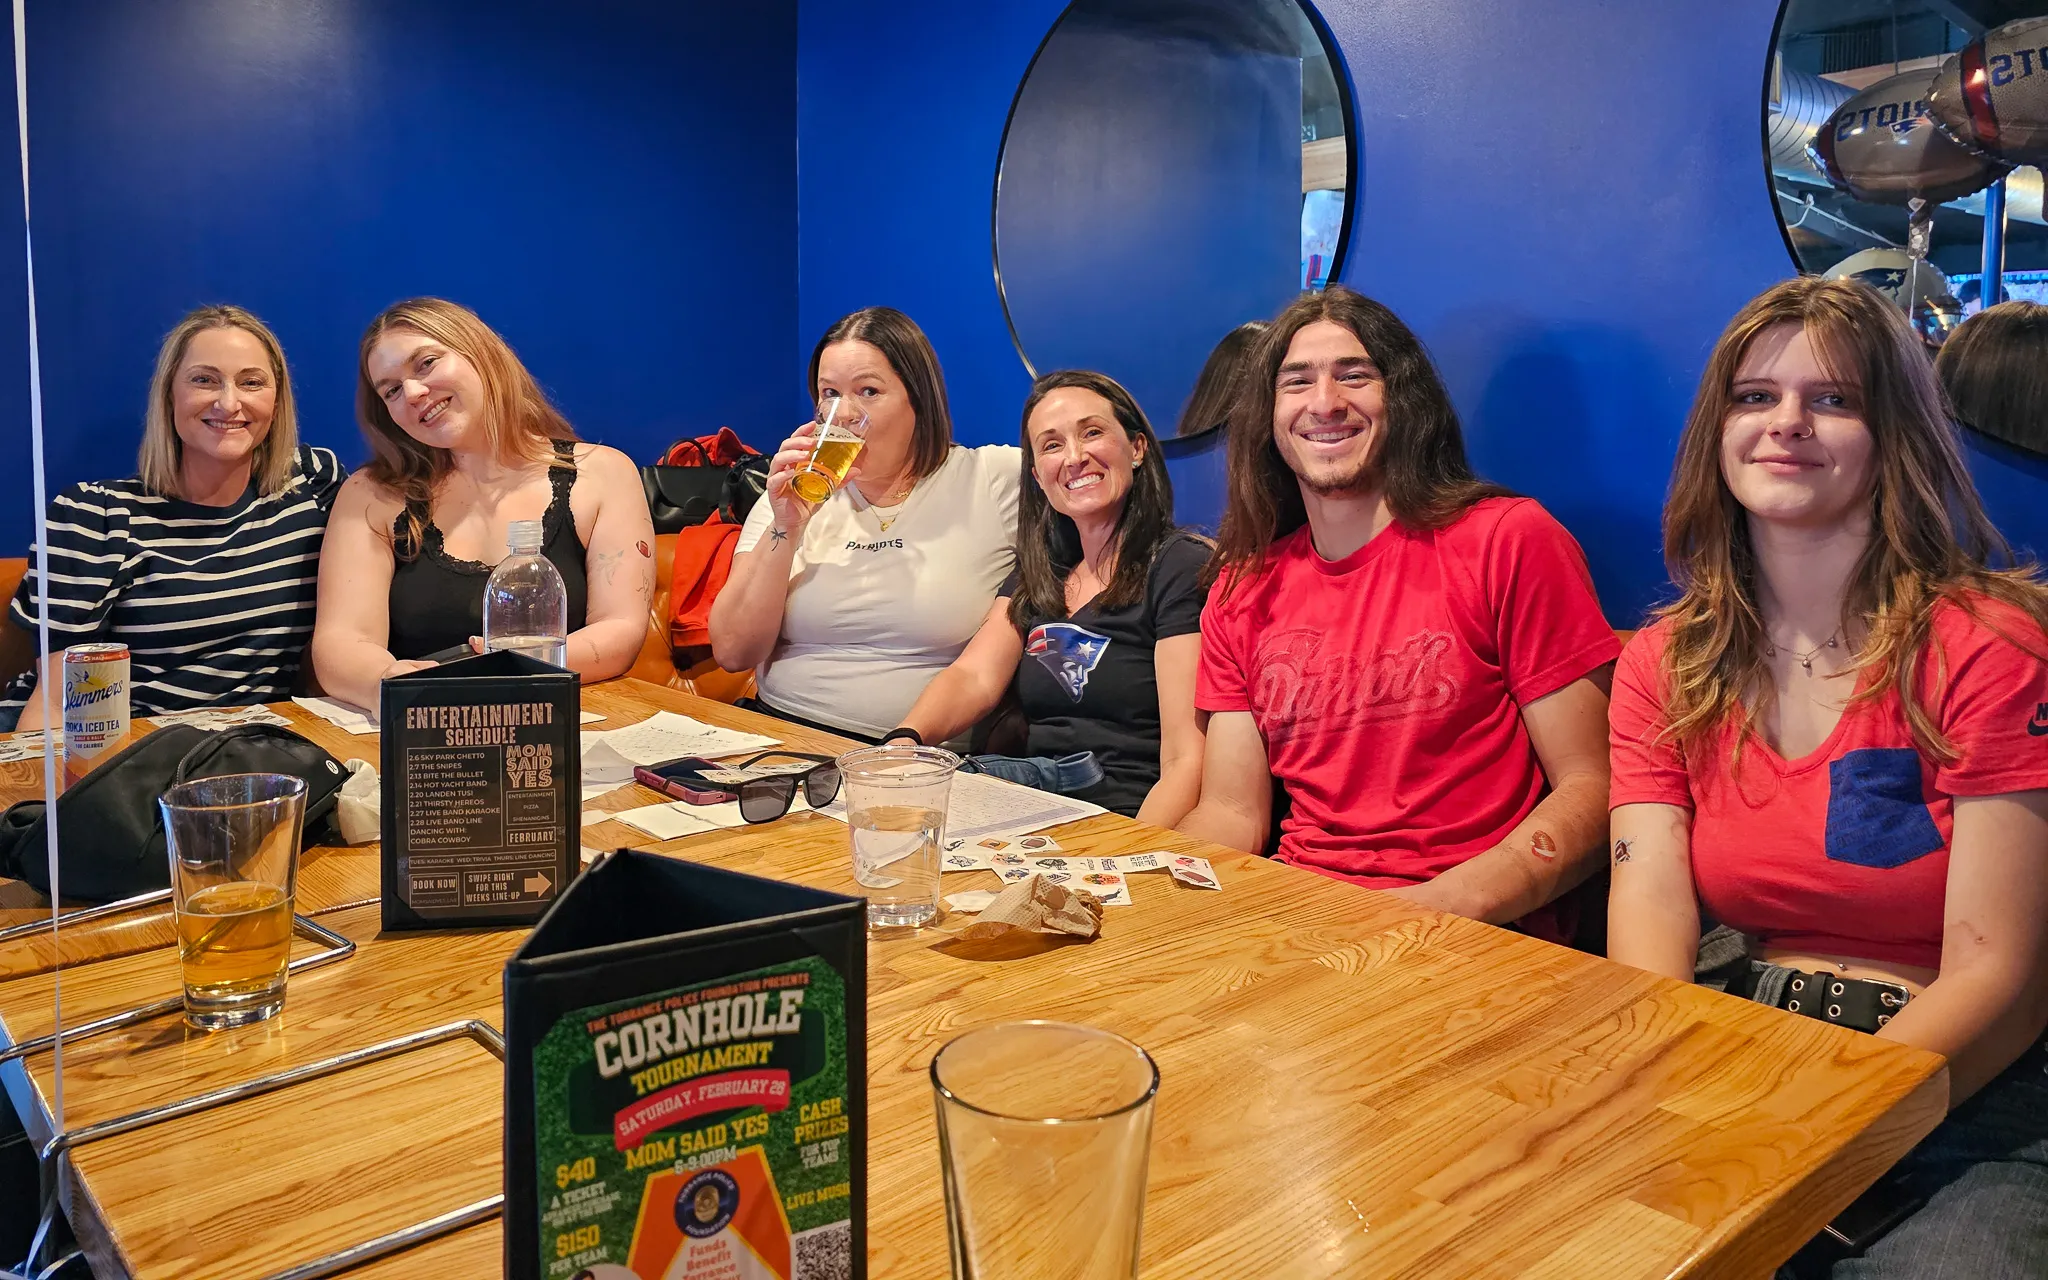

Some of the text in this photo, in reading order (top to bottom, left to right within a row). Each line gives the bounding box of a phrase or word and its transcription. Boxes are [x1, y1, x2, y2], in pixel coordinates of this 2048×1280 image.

[845, 538, 904, 552] PATRIOTS
[65, 680, 123, 712] Skimmers
[407, 702, 553, 729] ENTERTAINMENT
[85, 722, 104, 732] ICED
[106, 720, 120, 730] TEA
[445, 727, 517, 746] SCHEDULE
[456, 752, 485, 760] GHETTO
[506, 744, 552, 758] MOM
[506, 756, 552, 772] SAID
[508, 769, 552, 788] YES
[508, 791, 553, 799] ENTERTAINMENT
[465, 807, 500, 815] KARAOKE
[437, 836, 471, 844] COWBOY
[509, 831, 554, 843] FEBRUARY
[413, 878, 456, 890] BOOK NOW
[468, 872, 515, 883] SWIPE RIGHT
[475, 882, 508, 892] FOR THIS
[466, 891, 521, 903] WEEKS LINE-UP
[586, 1020, 608, 1034] THE
[594, 989, 805, 1080] CORNHOLE
[629, 1041, 774, 1096] TOURNAMENT
[619, 1079, 786, 1136] SATURDAY, FEBRUARY 28
[800, 1097, 843, 1123] CASH
[794, 1115, 849, 1145] PRIZES
[624, 1113, 770, 1172] MOM SAID YES
[802, 1151, 840, 1169] TEAMS
[556, 1156, 597, 1189] $40
[786, 1189, 815, 1210] LIVE
[556, 1224, 601, 1257] $150
[690, 1239, 727, 1258] Funds
[573, 1245, 609, 1267] TEAM
[686, 1250, 732, 1271] Benefit
